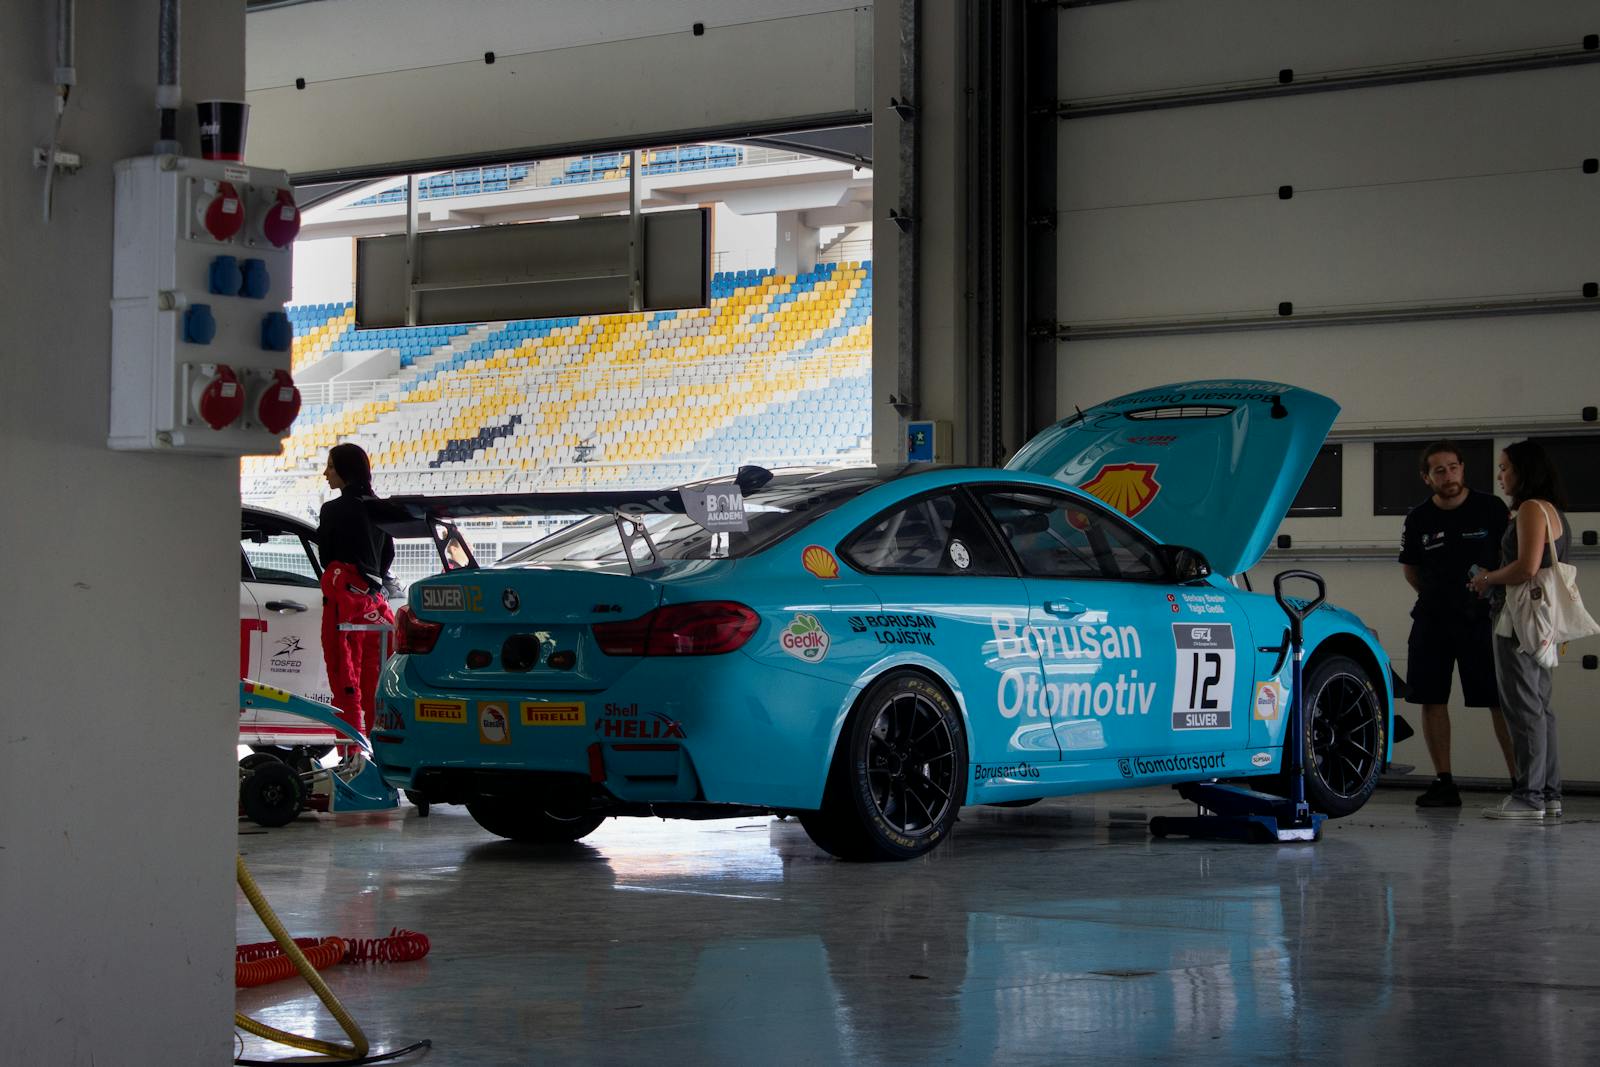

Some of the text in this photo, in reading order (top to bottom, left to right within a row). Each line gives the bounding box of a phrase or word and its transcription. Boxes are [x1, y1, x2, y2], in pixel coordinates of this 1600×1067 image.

[707, 494, 742, 511] BOM
[423, 589, 462, 607] SILVER
[866, 615, 937, 630] BORUSAN
[783, 633, 825, 649] Gedik
[991, 611, 1142, 660] Borusan
[1191, 627, 1212, 641] GT4
[271, 659, 302, 668] TOSFED
[1189, 652, 1221, 710] 12
[997, 668, 1157, 719] Otomotiv
[420, 703, 462, 719] PIRELLI
[527, 706, 579, 721] PIRELLI
[604, 703, 638, 717] Shell
[604, 715, 684, 738] HELIX
[1186, 713, 1218, 728] SILVER
[974, 761, 1041, 780] Borusan Oto
